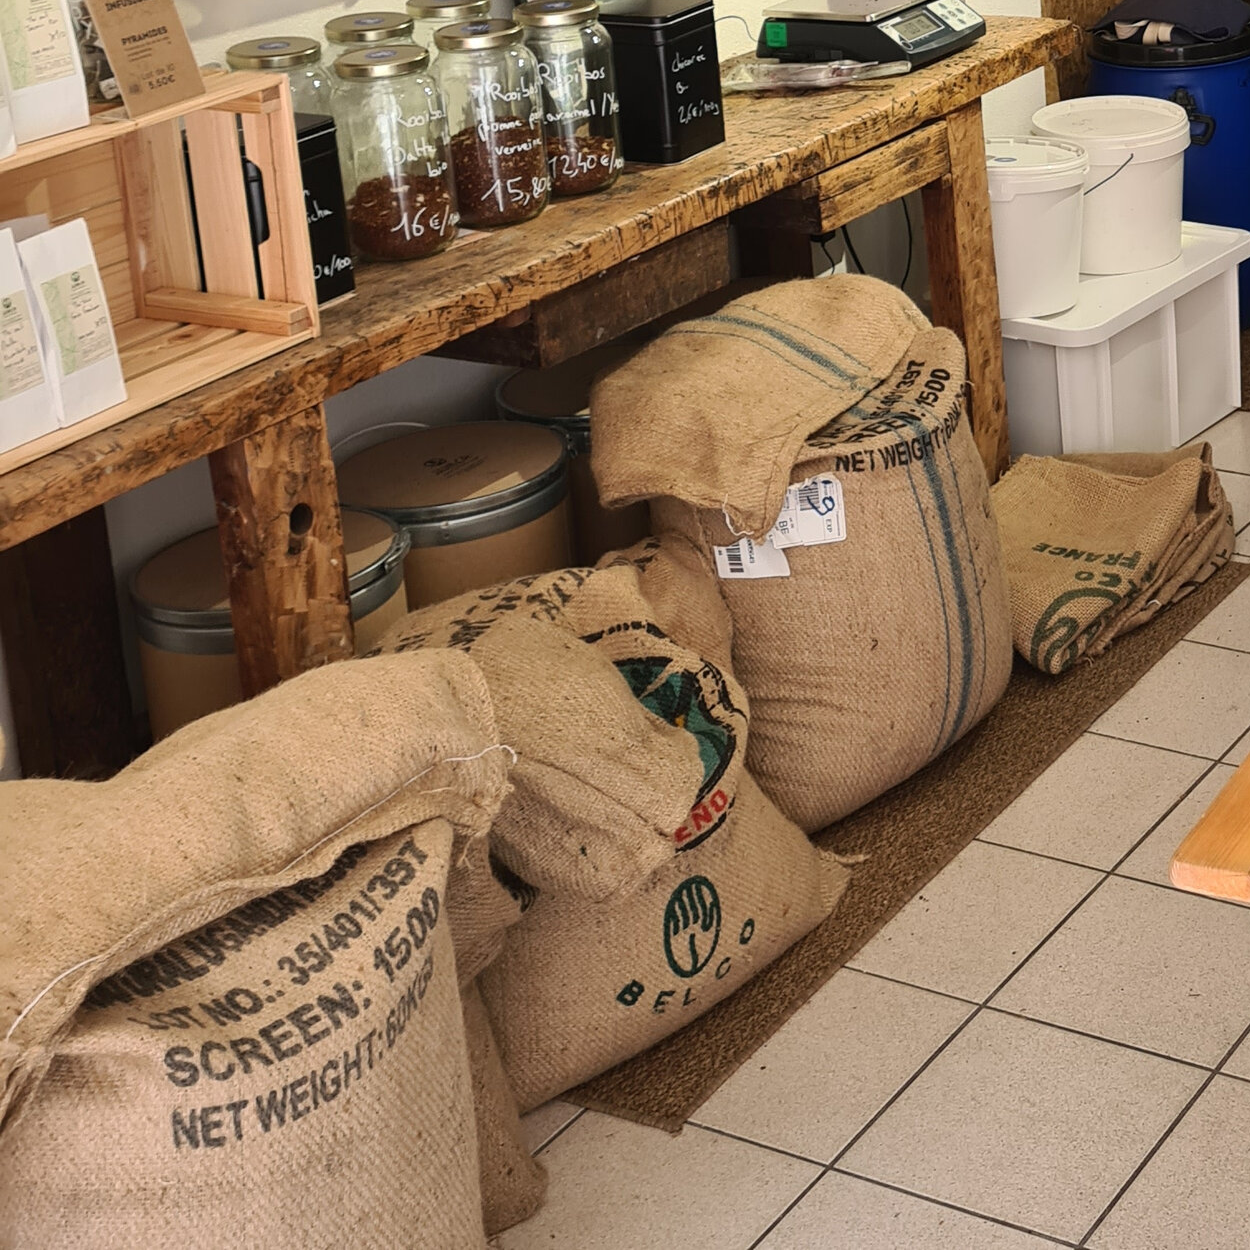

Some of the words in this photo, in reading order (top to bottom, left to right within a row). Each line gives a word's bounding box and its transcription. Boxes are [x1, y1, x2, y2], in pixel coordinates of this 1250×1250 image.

[835, 449, 877, 473] NET
[164, 981, 372, 1089] SCREEN:
[374, 886, 440, 984] 1500
[616, 917, 755, 1015] BELCO
[171, 1099, 249, 1150] NET
